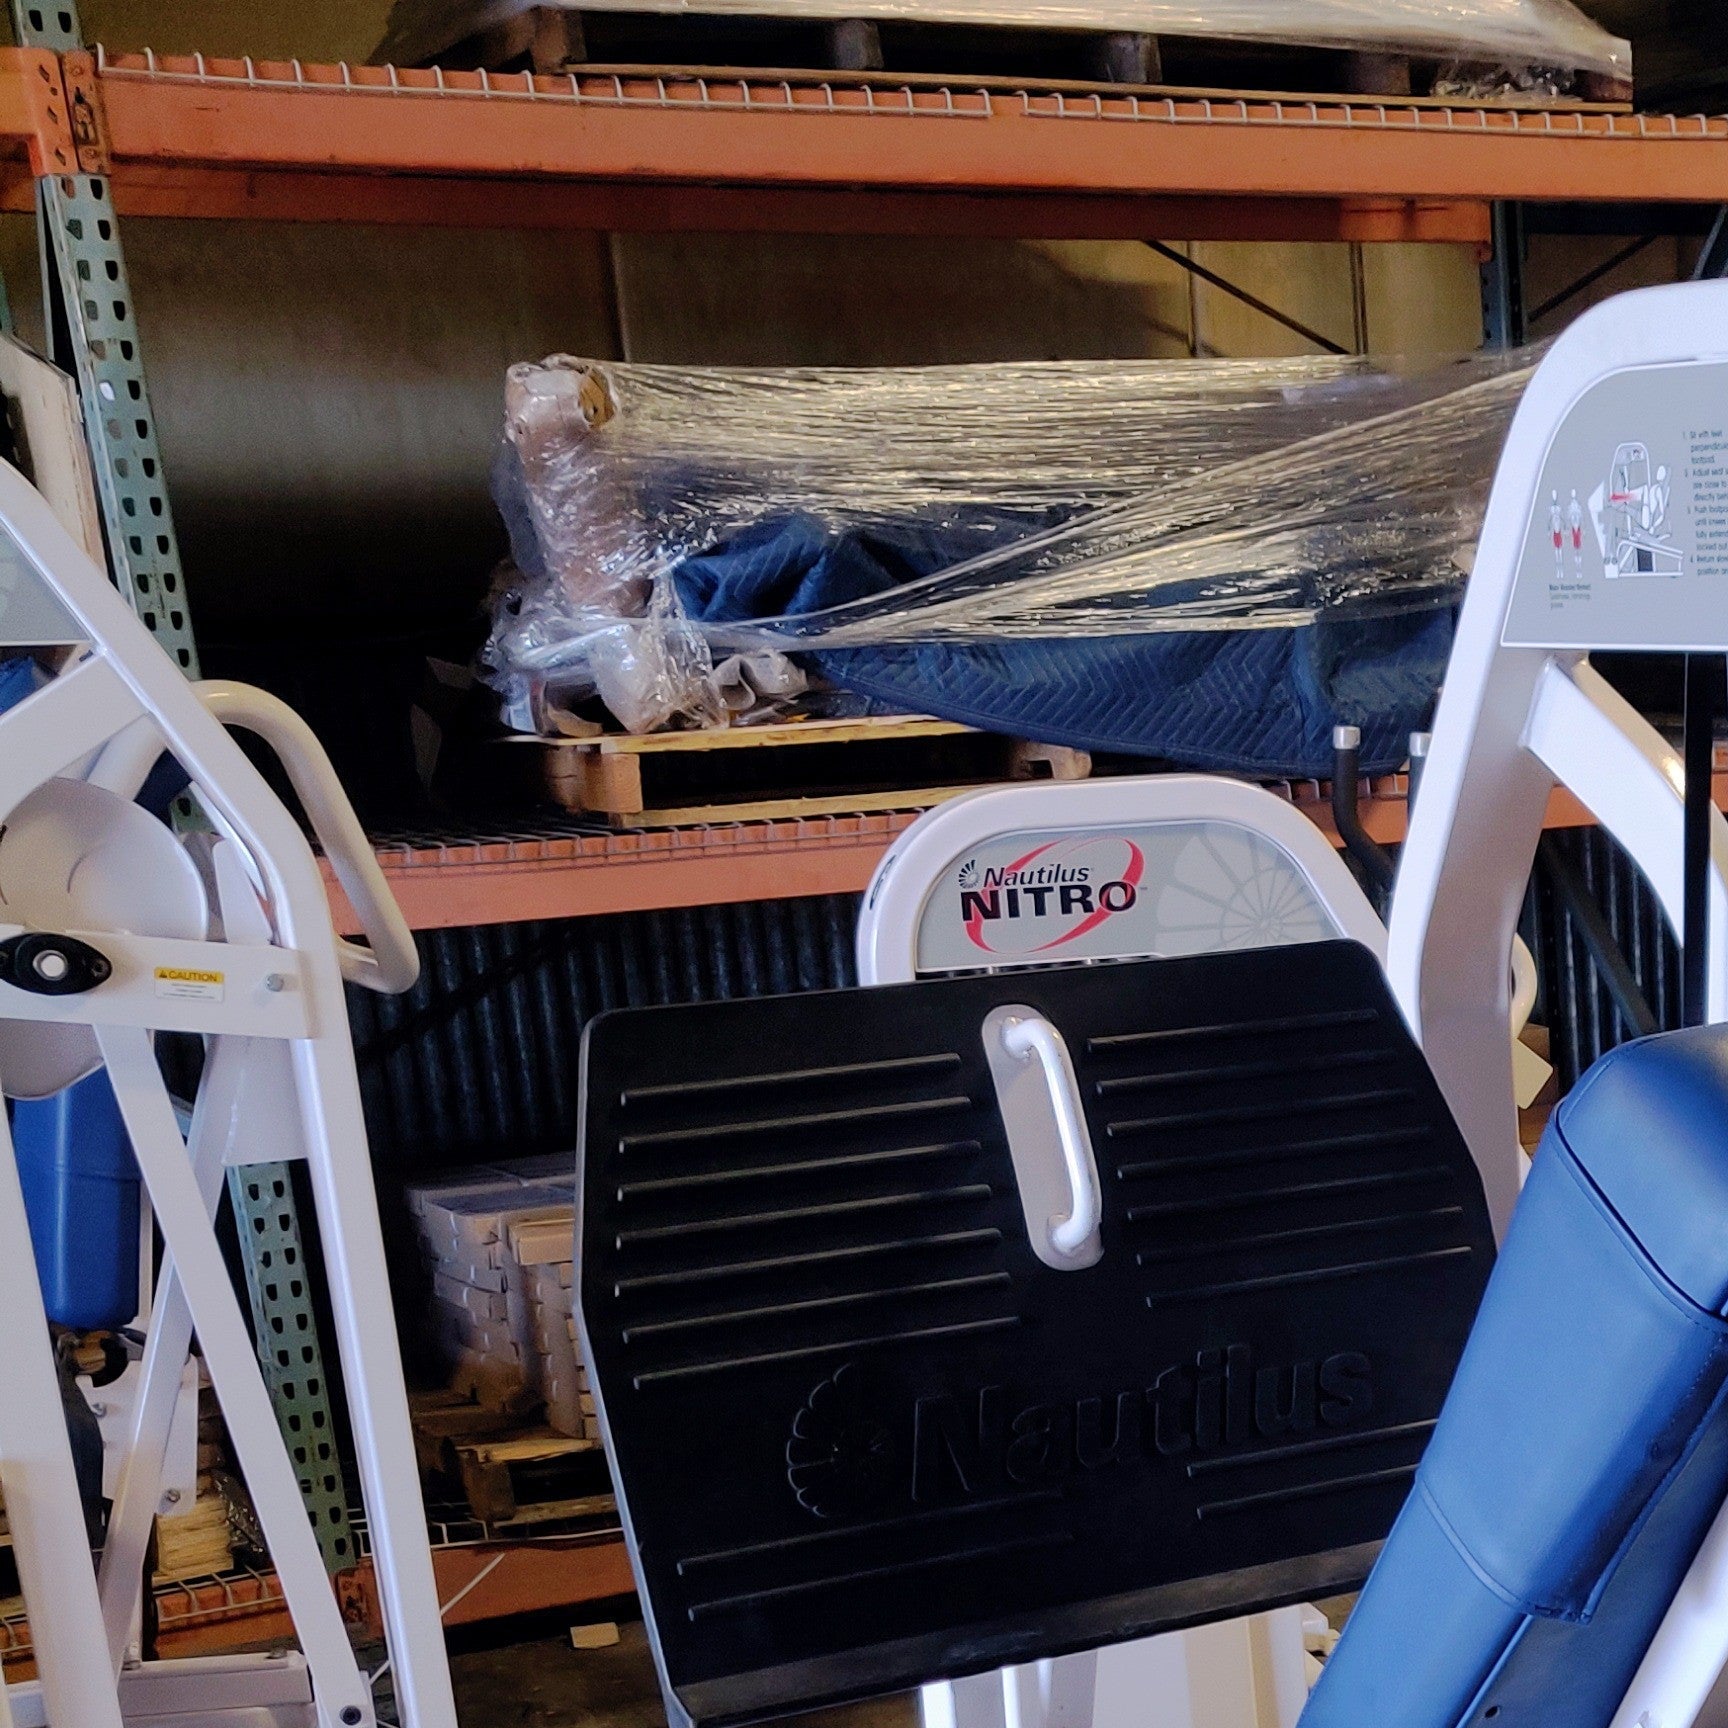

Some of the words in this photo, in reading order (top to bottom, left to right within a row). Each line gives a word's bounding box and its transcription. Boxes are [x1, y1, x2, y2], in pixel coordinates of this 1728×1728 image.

[983, 863, 1090, 888] Nautilus
[960, 880, 1137, 922] NITRO
[169, 970, 218, 983] CAUTION
[910, 1342, 1378, 1502] Nautilus
